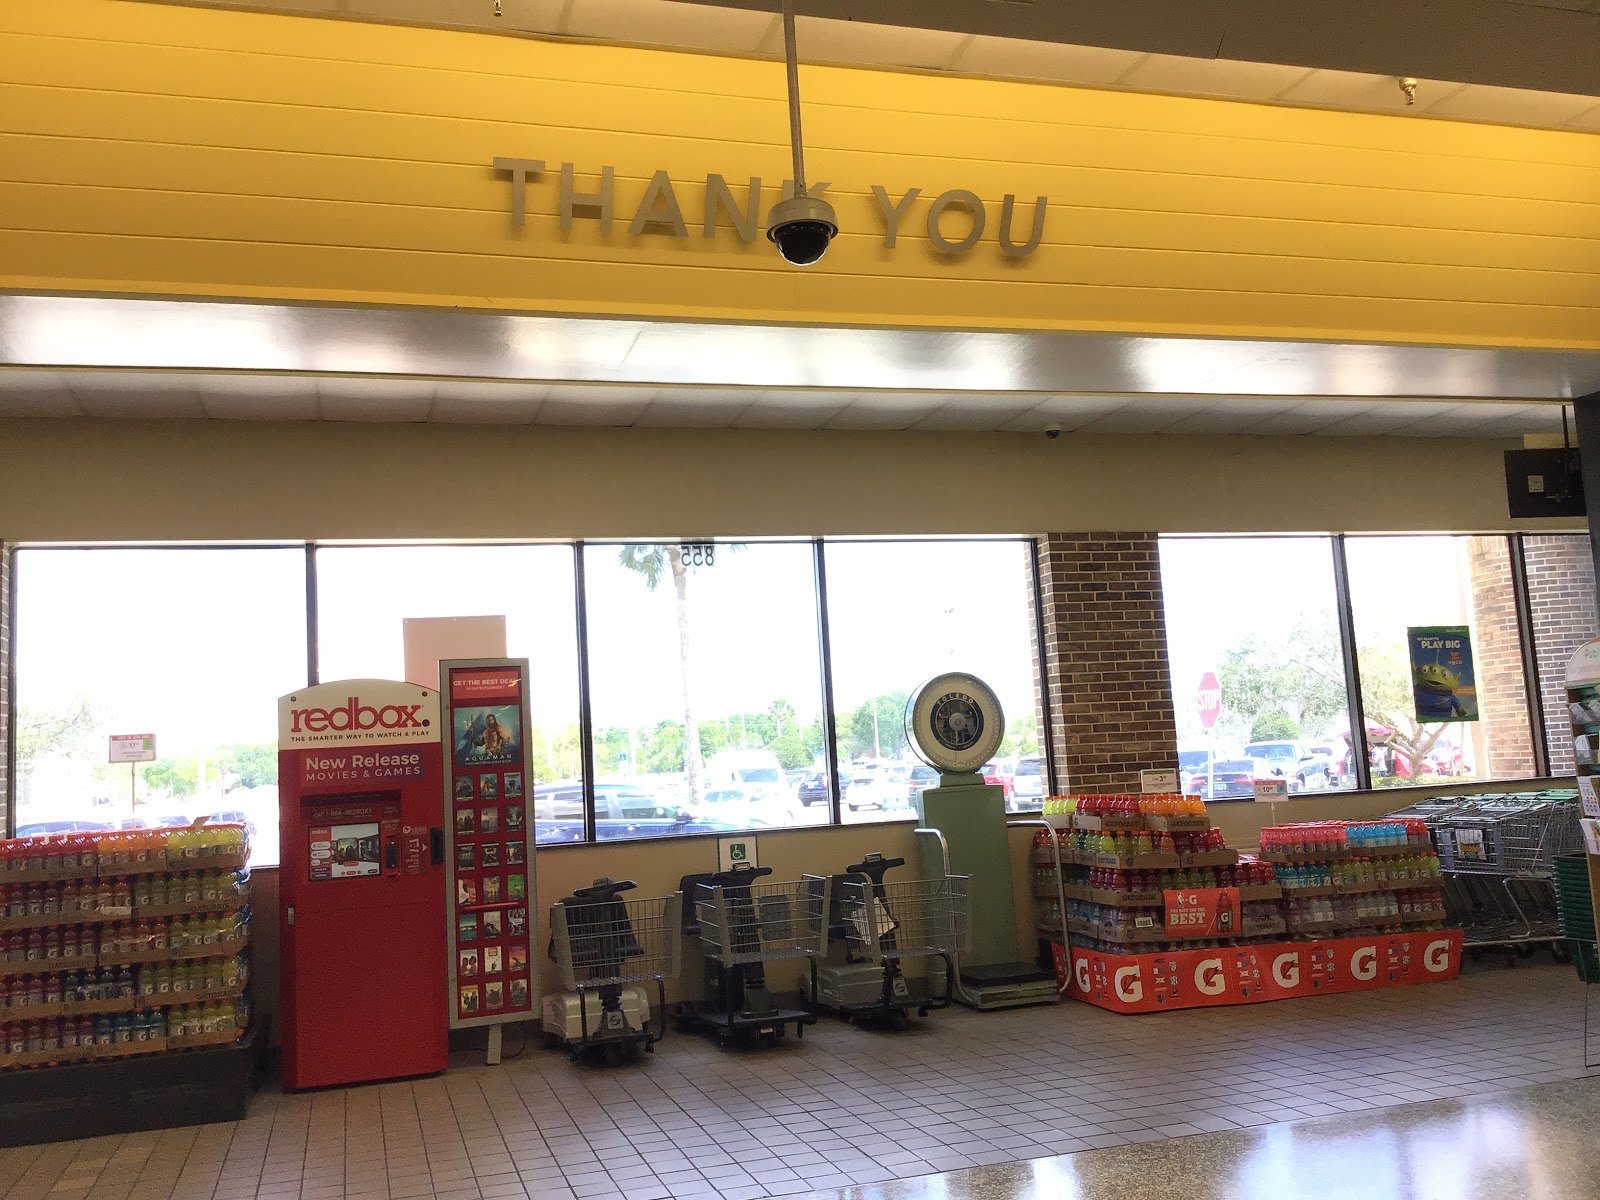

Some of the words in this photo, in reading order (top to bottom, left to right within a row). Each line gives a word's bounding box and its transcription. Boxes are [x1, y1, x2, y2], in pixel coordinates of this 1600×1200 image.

[870, 185, 1047, 257] YOU
[1421, 640, 1444, 649] PLAY
[1445, 640, 1461, 649] BIG
[937, 693, 974, 705] TOLEDO
[1199, 688, 1219, 711] STOP
[306, 757, 346, 770] New
[352, 753, 420, 768] Release
[465, 754, 512, 762] AQUAMAN
[306, 770, 358, 781] MOVIES
[363, 769, 370, 778] &
[375, 766, 421, 777] GAMES
[1122, 893, 1157, 901] GATORADE
[1189, 895, 1197, 905] G
[1170, 912, 1206, 925] BEST
[1221, 913, 1229, 922] G
[1351, 946, 1377, 981] G
[1423, 939, 1449, 973] G
[1076, 958, 1091, 993] G
[1194, 958, 1226, 996] G
[1272, 952, 1300, 988] G
[1115, 965, 1143, 1003] G
